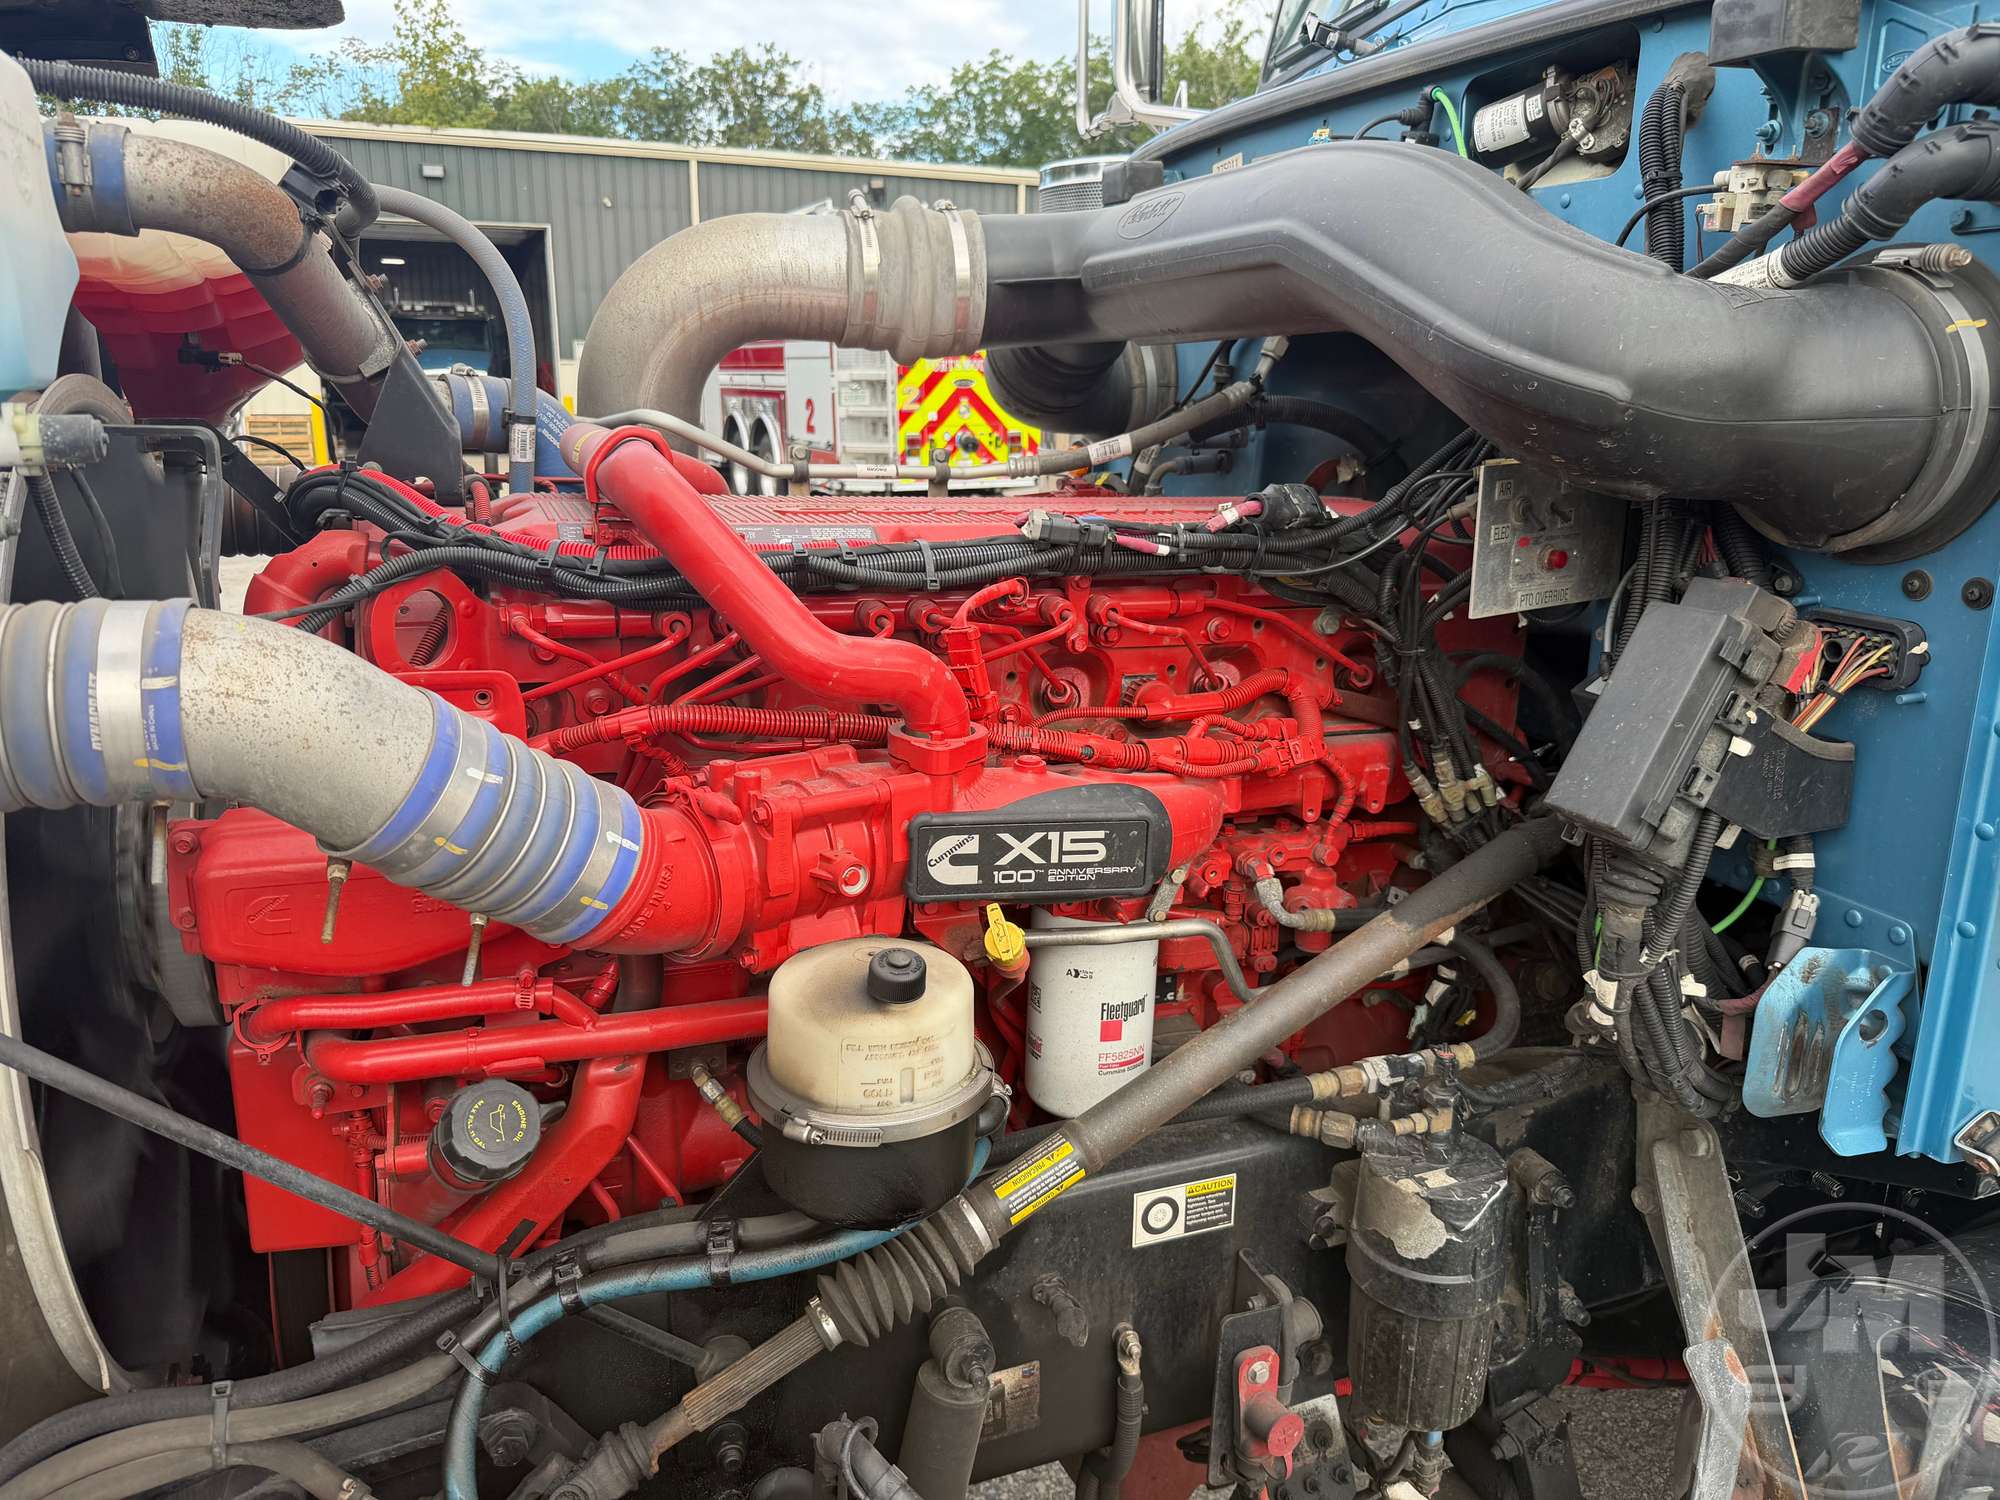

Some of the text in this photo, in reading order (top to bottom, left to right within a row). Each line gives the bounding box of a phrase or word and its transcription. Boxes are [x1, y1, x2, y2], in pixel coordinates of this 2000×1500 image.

[805, 398, 816, 434] 2
[1499, 481, 1512, 496] AIR
[1493, 525, 1511, 541] ELEC
[1519, 587, 1569, 607] PTO OVERRIDE
[928, 833, 975, 868] Cummins
[994, 830, 1107, 866] X15
[1048, 866, 1137, 876] ANNIVERSARY
[1048, 874, 1096, 882] EDITION
[620, 864, 674, 940] MADE IN USA
[1100, 996, 1146, 1022] Fleetguard
[1098, 1043, 1144, 1062] FF5825NN
[512, 1100, 527, 1142] ENGINE OIL
[1195, 1179, 1233, 1193] CAUTION
